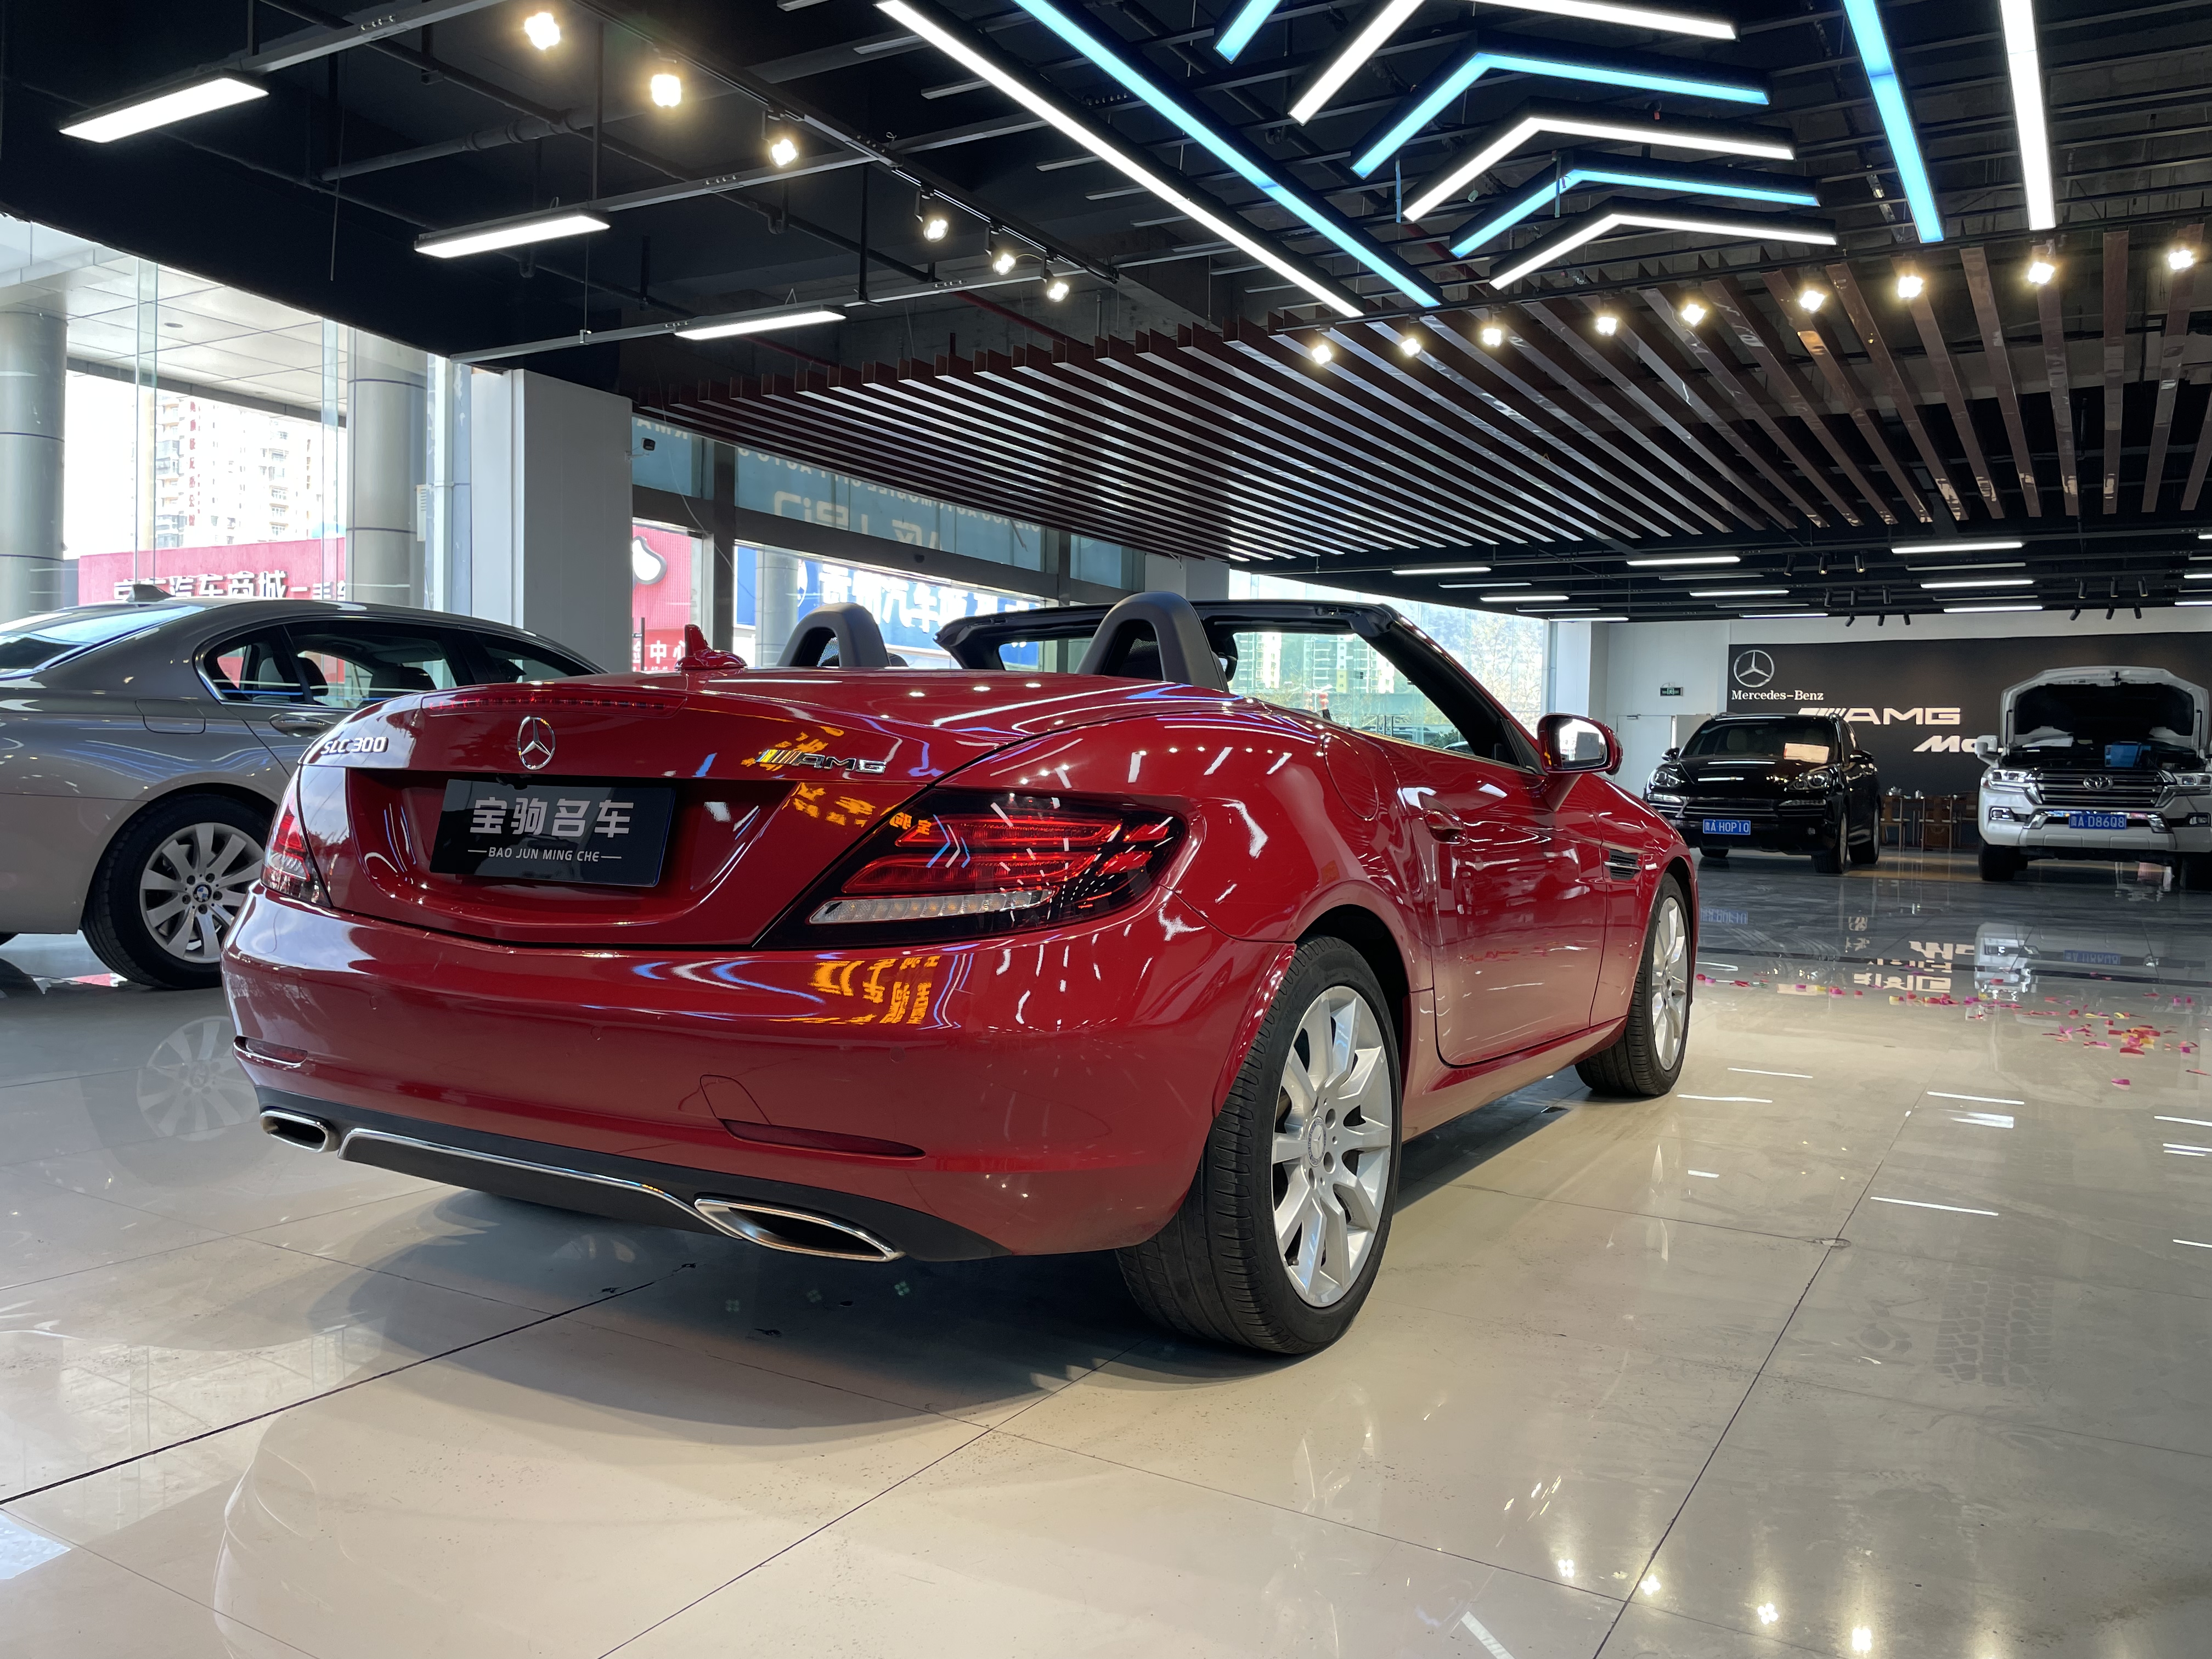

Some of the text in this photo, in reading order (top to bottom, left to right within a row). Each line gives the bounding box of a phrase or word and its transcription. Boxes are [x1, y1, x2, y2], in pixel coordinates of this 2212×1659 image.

[114, 570, 286, 600] 汽车商城
[1731, 690, 1825, 701] Mercedes-Benz
[1843, 707, 1961, 725] AMG
[320, 737, 388, 755] SLC 300
[799, 752, 887, 774] AMG
[470, 797, 634, 838] 宝驹名车
[488, 847, 600, 862] BAO JUN MING CHE
